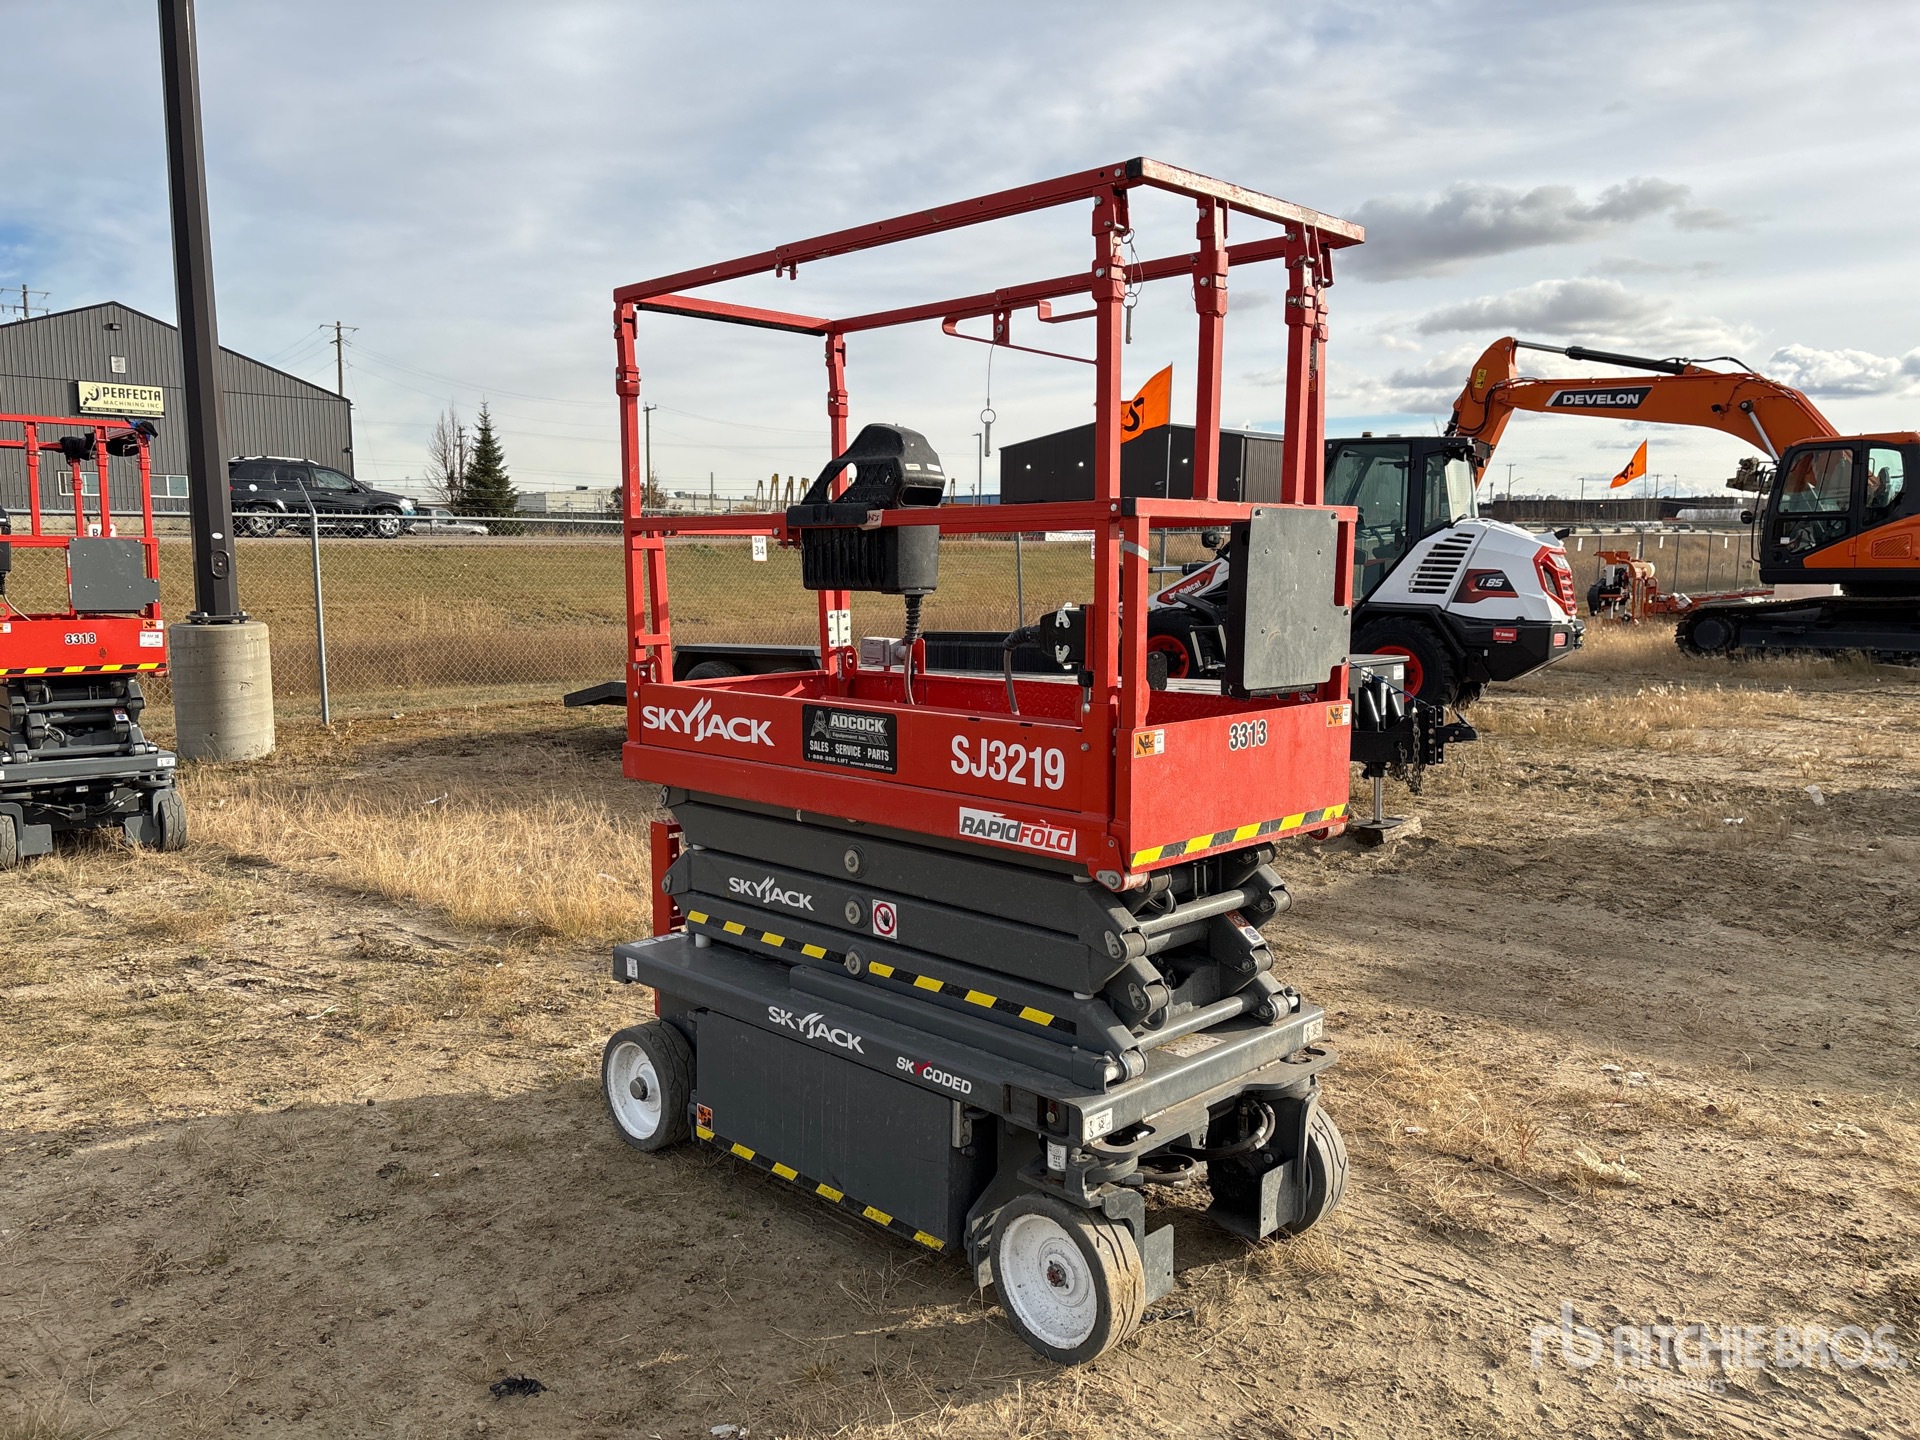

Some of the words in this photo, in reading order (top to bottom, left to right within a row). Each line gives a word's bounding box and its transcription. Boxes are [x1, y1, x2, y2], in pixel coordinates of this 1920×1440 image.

[102, 387, 161, 401] PERFECTA
[103, 400, 145, 408] MACHINING
[1562, 394, 1640, 405] DEVELON
[754, 545, 765, 556] 34
[64, 632, 97, 645] 3318
[642, 697, 775, 747] SKYJACK
[830, 714, 886, 734] ADCOCK
[1229, 719, 1268, 751] 3313
[809, 740, 829, 753] SALES
[835, 743, 861, 757] SERVICE
[867, 748, 889, 761] PARTS
[950, 734, 1065, 791] SJ3219
[728, 876, 815, 911] SKYJACK
[768, 1006, 865, 1054] SKYJACK
[896, 1056, 972, 1095] SKYCODED
